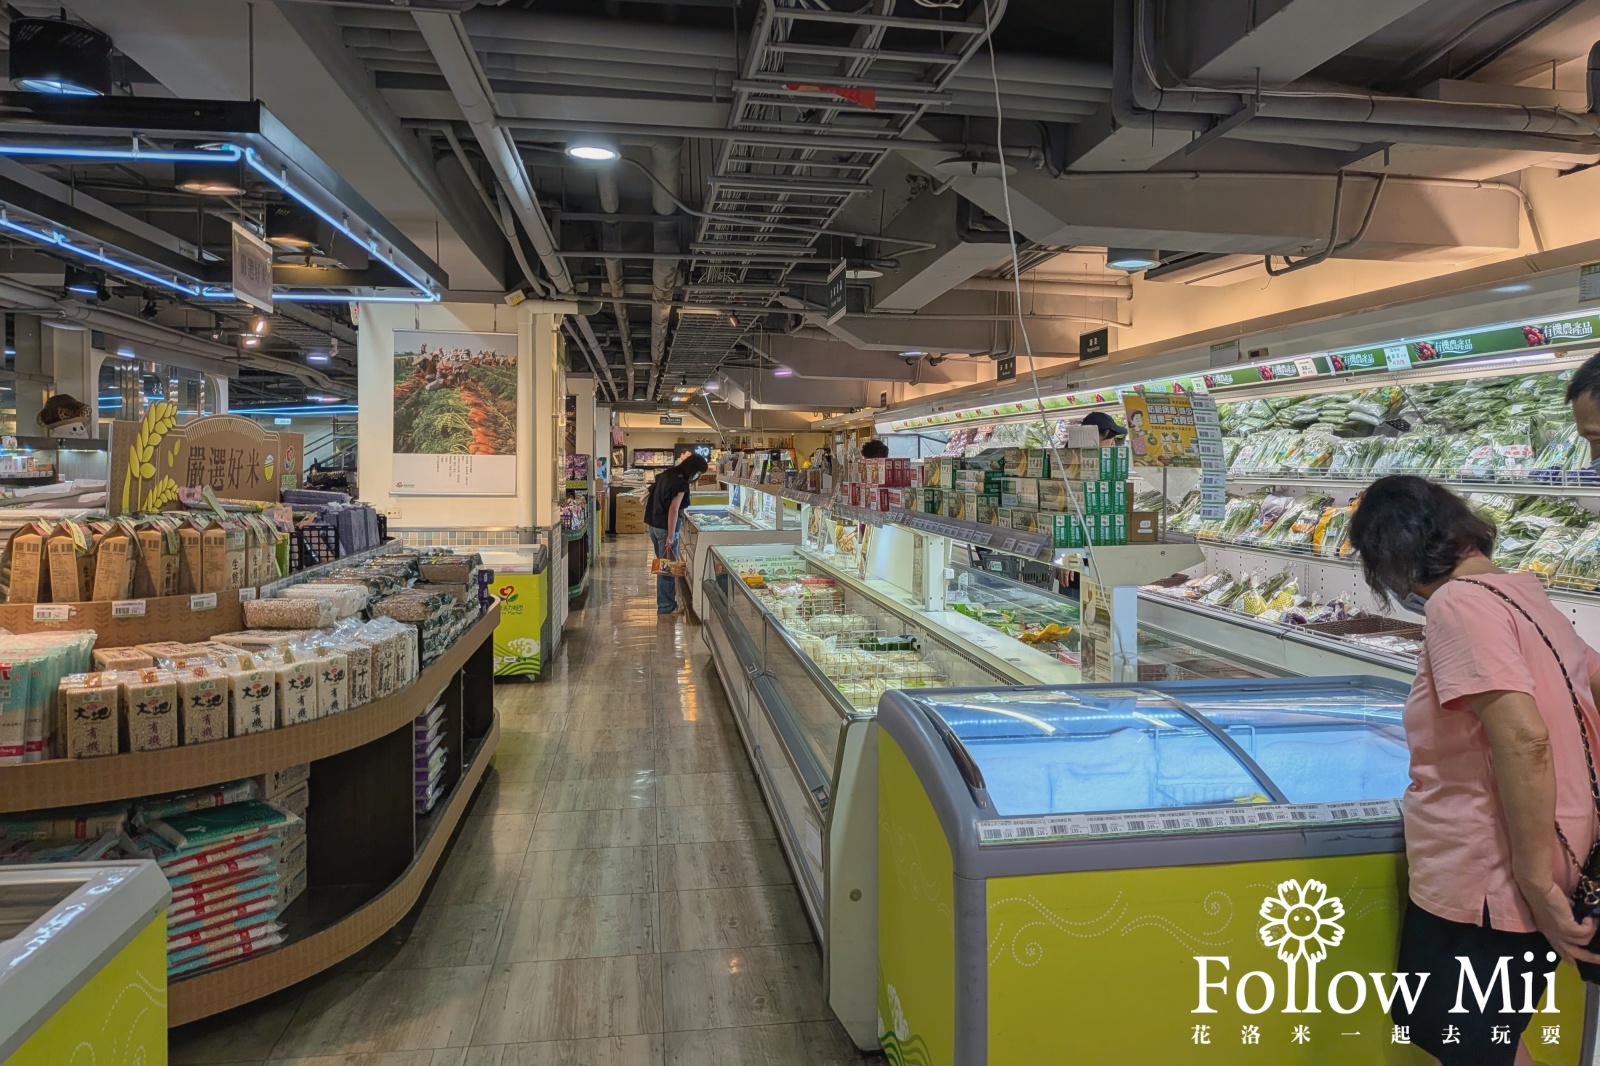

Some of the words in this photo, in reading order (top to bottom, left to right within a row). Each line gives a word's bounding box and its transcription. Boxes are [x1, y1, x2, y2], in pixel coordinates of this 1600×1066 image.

[1543, 321, 1593, 337] 有機農產品
[1434, 338, 1473, 351] 有機農產品
[186, 445, 260, 491] 嚴選好米
[288, 676, 314, 690] 大地
[322, 668, 346, 683] 大地
[242, 684, 272, 699] 大地
[136, 701, 172, 716] 大地
[191, 693, 224, 708] 大地
[73, 705, 113, 721] 大地
[251, 704, 264, 729] 有機
[147, 721, 160, 745] 有機
[201, 713, 214, 738] 有機
[85, 726, 100, 752] 有機
